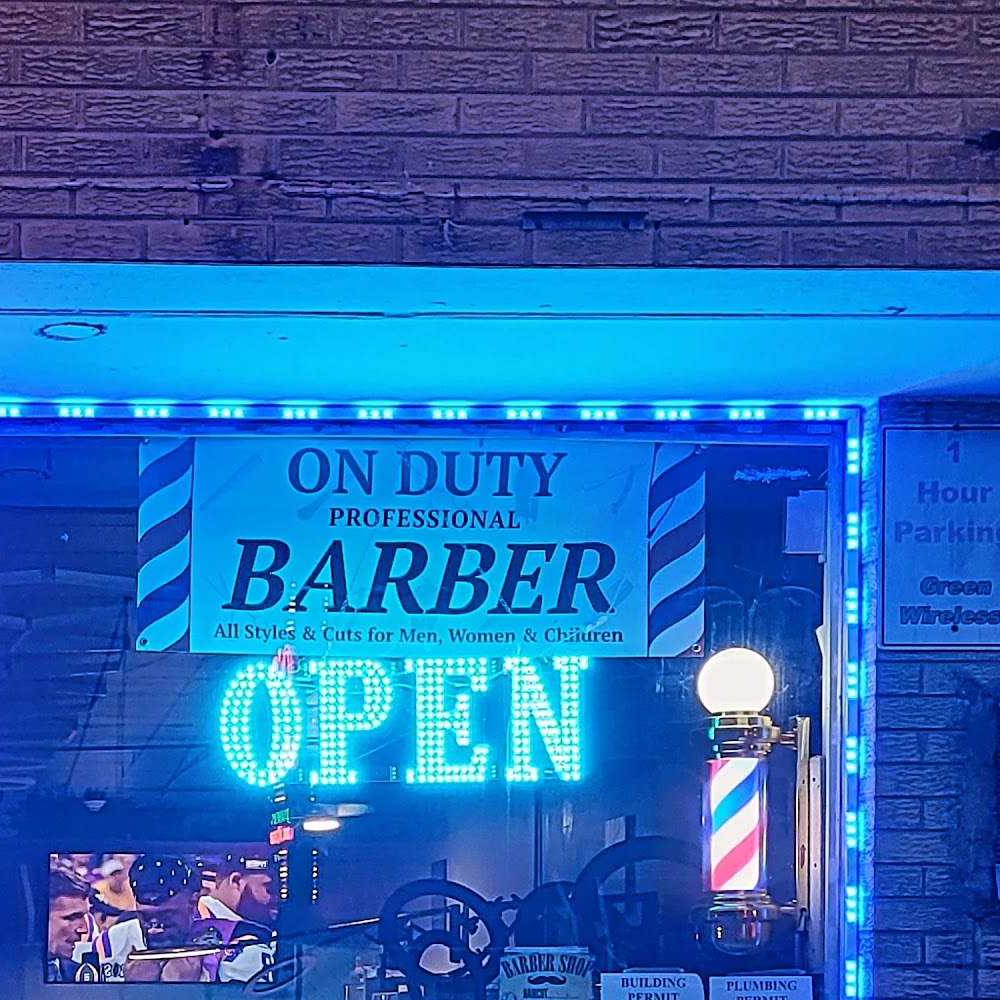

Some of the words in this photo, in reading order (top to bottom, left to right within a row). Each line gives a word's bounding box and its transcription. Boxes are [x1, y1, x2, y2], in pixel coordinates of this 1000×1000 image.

[946, 440, 961, 464] 1
[288, 447, 378, 496] ON
[396, 449, 568, 498] DUTY
[917, 480, 993, 504] Hour
[328, 508, 521, 530] PROFESSIONAL
[221, 537, 617, 616] BARBER
[919, 575, 993, 596] Green
[899, 605, 1000, 626] Wireless
[213, 623, 239, 641] All
[244, 623, 297, 645] Styles
[303, 627, 317, 643] &
[322, 626, 363, 645] Cuts
[367, 626, 395, 644] for
[399, 628, 444, 647] Men,
[447, 628, 517, 645] Women
[523, 628, 538, 644] &
[219, 655, 589, 787] OPEN
[501, 953, 555, 979] BARBER
[620, 977, 687, 989] BUILDING
[726, 980, 798, 992] PLUMBING
